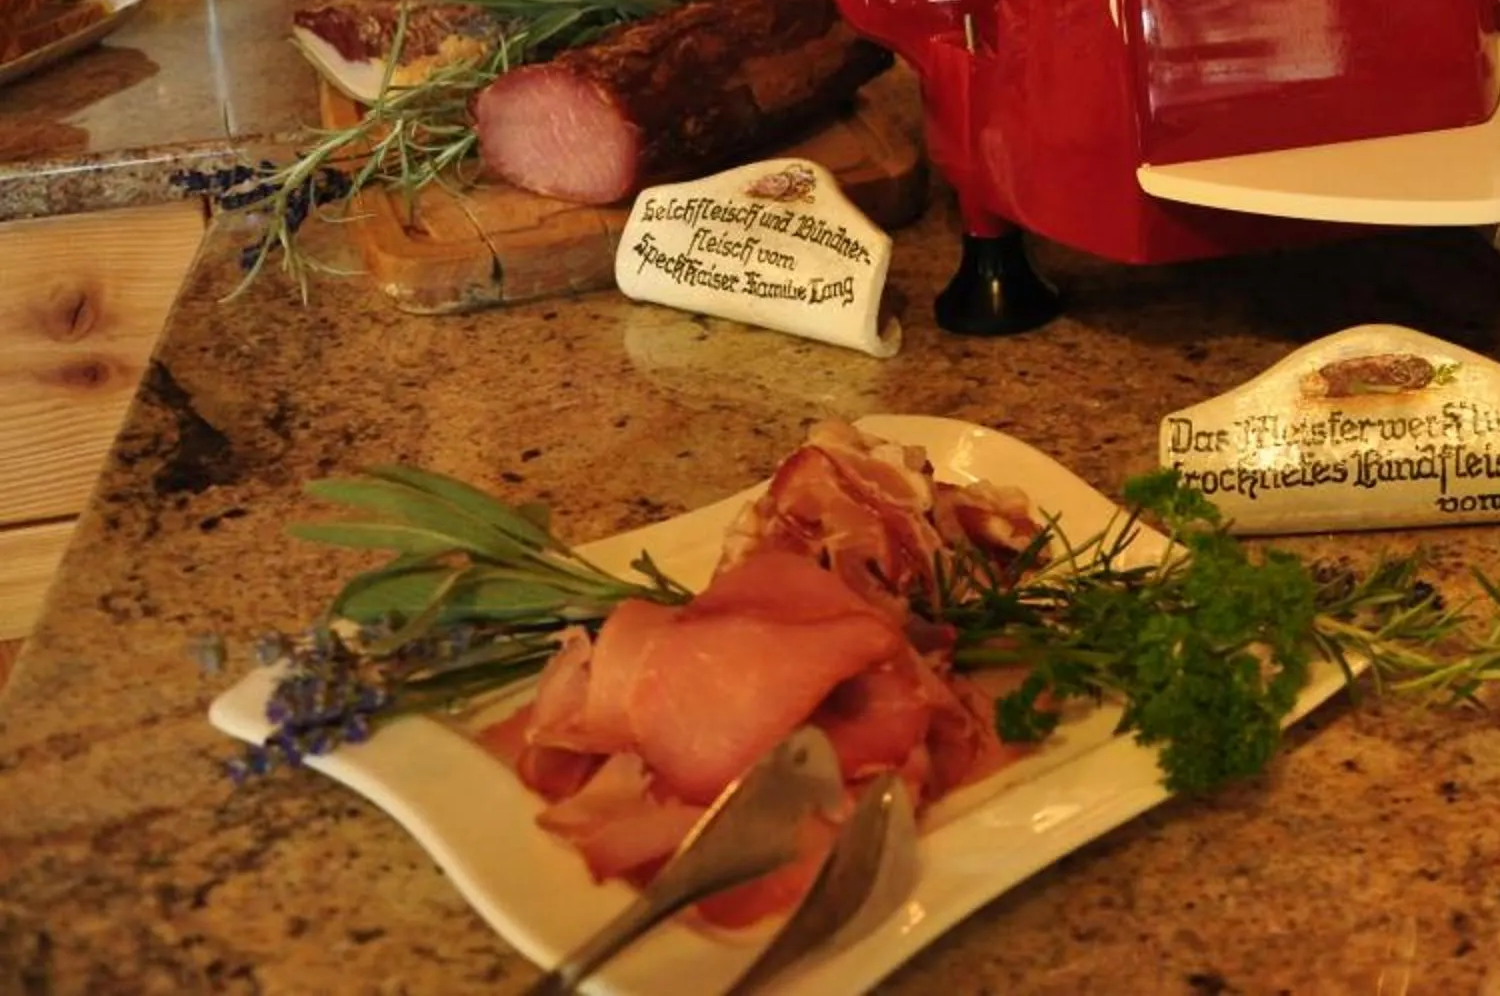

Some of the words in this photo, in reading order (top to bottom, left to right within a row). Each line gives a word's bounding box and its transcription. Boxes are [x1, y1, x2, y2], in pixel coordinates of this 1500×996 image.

[641, 197, 761, 232] Selchfleisch
[759, 210, 795, 234] und
[791, 214, 872, 266] Bündner-
[687, 227, 761, 267] fleisch
[756, 248, 796, 271] vom
[741, 271, 807, 301] Familie
[807, 276, 855, 308] Lang
[1168, 417, 1231, 454] Das
